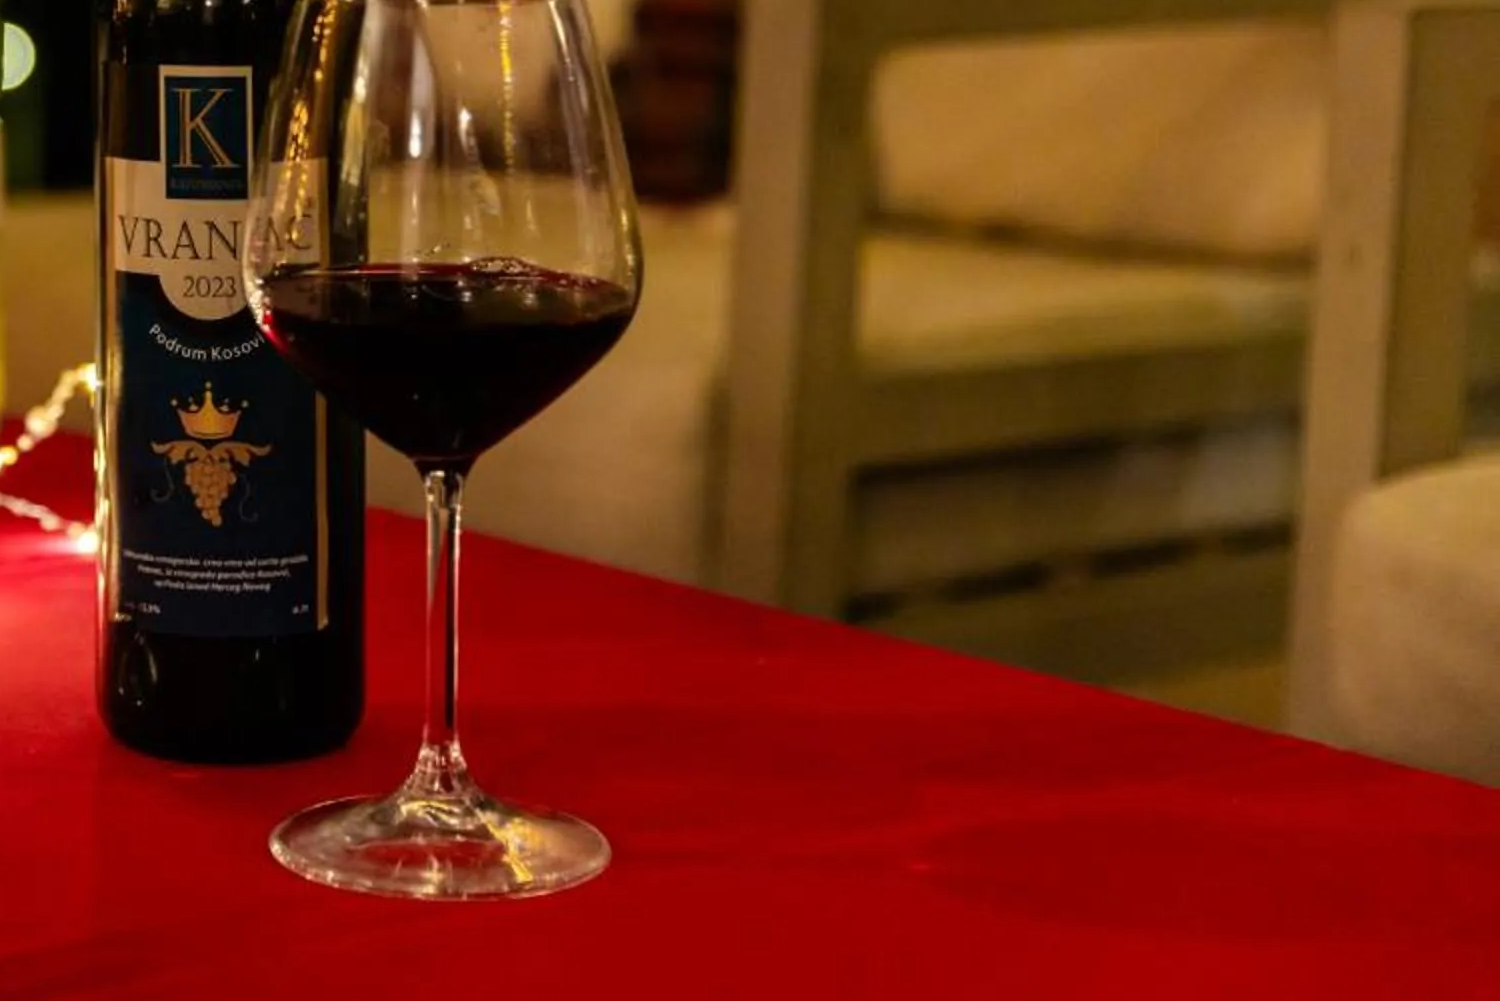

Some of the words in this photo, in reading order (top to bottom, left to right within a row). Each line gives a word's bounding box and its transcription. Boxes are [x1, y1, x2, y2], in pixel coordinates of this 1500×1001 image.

[172, 87, 242, 169] K
[182, 275, 237, 299] 2023
[148, 322, 208, 361] Podrum
[210, 331, 267, 361] Kosovi
